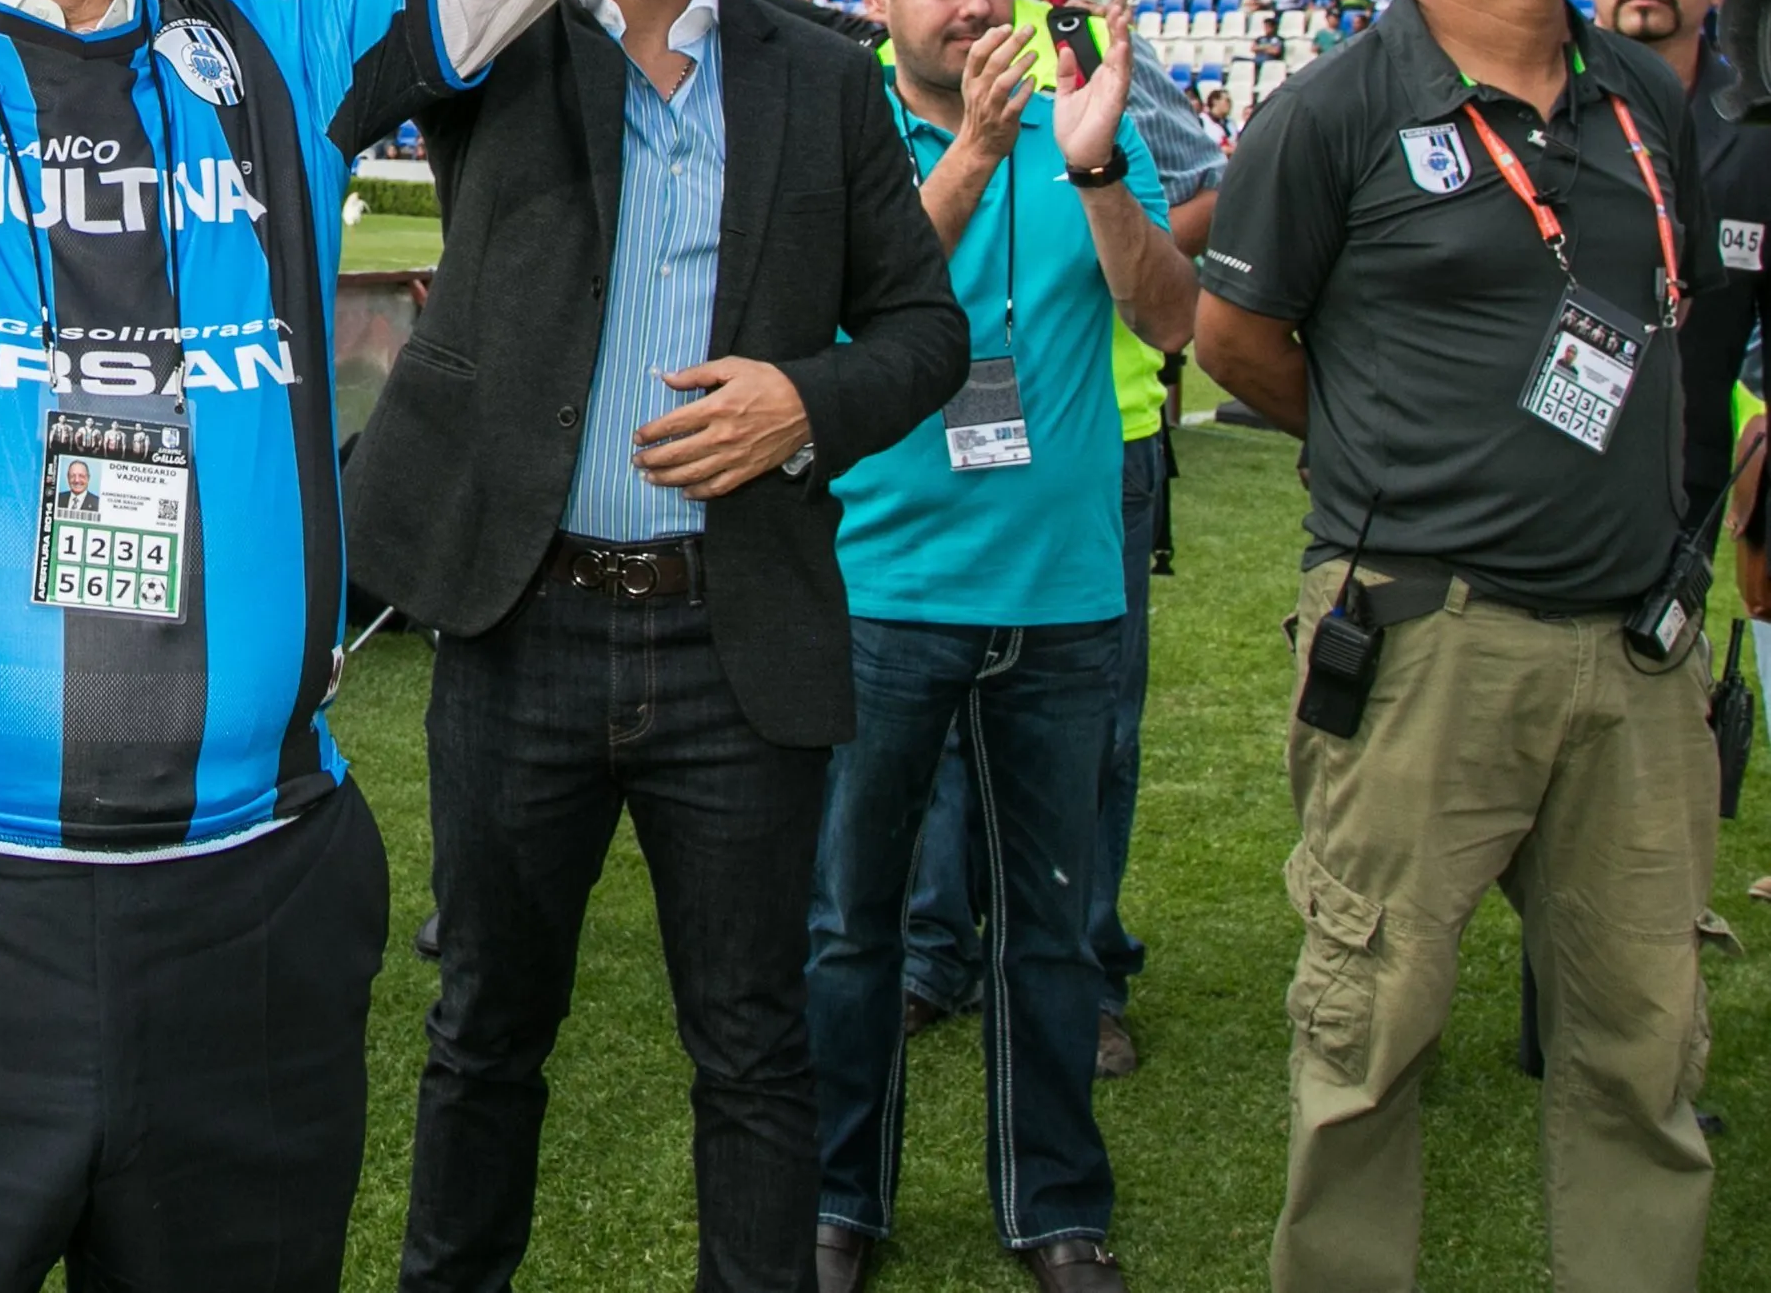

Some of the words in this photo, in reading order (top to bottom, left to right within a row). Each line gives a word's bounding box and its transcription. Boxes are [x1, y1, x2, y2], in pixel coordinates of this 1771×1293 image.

[1721, 227, 1760, 252] 045
[1551, 382, 1560, 395] 1
[1567, 390, 1576, 403] 2
[1582, 398, 1592, 411] 3
[1597, 408, 1607, 420] 4
[1542, 403, 1552, 415] 5
[1558, 411, 1567, 423] 6
[1574, 418, 1583, 430] 7
[109, 463, 128, 472] DON
[131, 466, 177, 477] OLEGARIO
[152, 453, 187, 466] GALLOS
[116, 473, 157, 485] VAZQUEZ
[44, 502, 54, 532] 2014
[63, 535, 77, 555] 1
[90, 538, 106, 558] 2
[117, 540, 134, 561] 3
[147, 545, 163, 565] 4
[37, 534, 53, 599] APERTURA
[59, 573, 75, 593] 5
[87, 576, 103, 596] 6
[115, 579, 131, 599] 7
